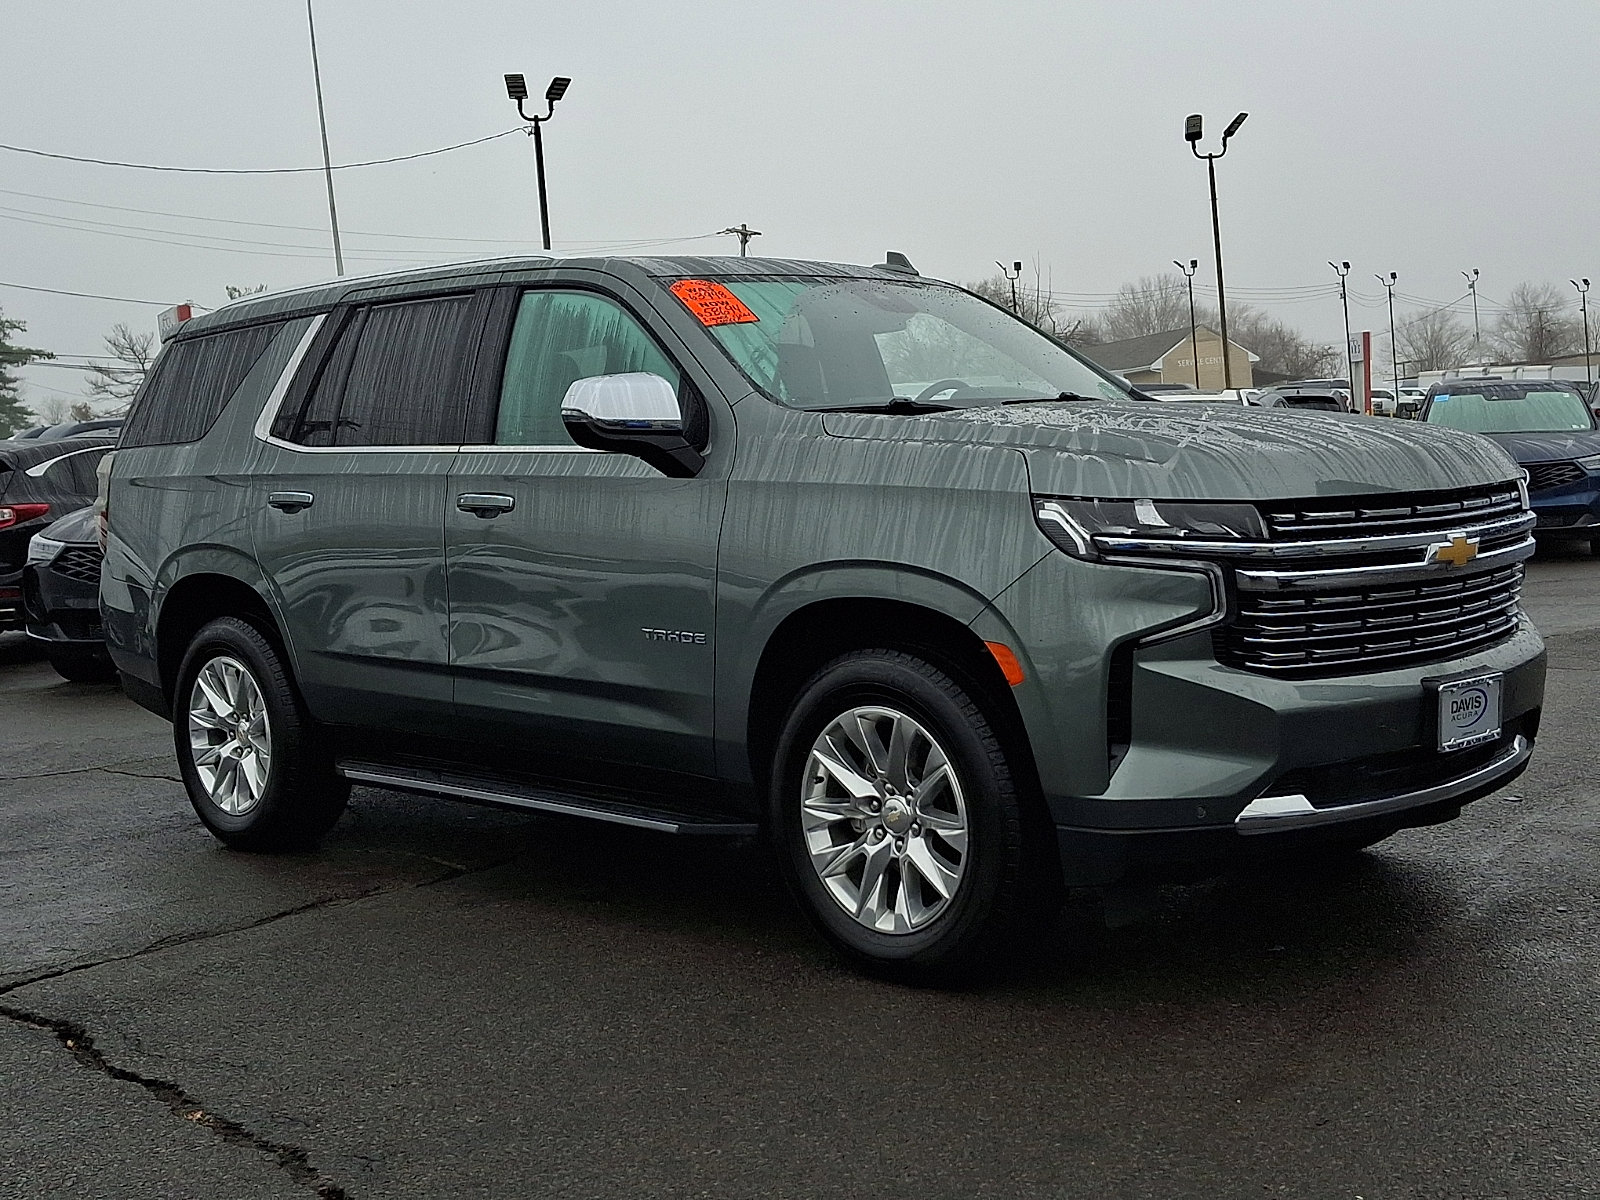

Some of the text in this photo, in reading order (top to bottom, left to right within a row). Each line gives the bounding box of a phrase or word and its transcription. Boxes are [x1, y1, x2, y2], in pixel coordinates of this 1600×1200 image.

[698, 300, 730, 308] NOW
[641, 628, 706, 644] TAHOE
[1451, 695, 1482, 715] DAVIS
[1451, 710, 1479, 722] ACURA
